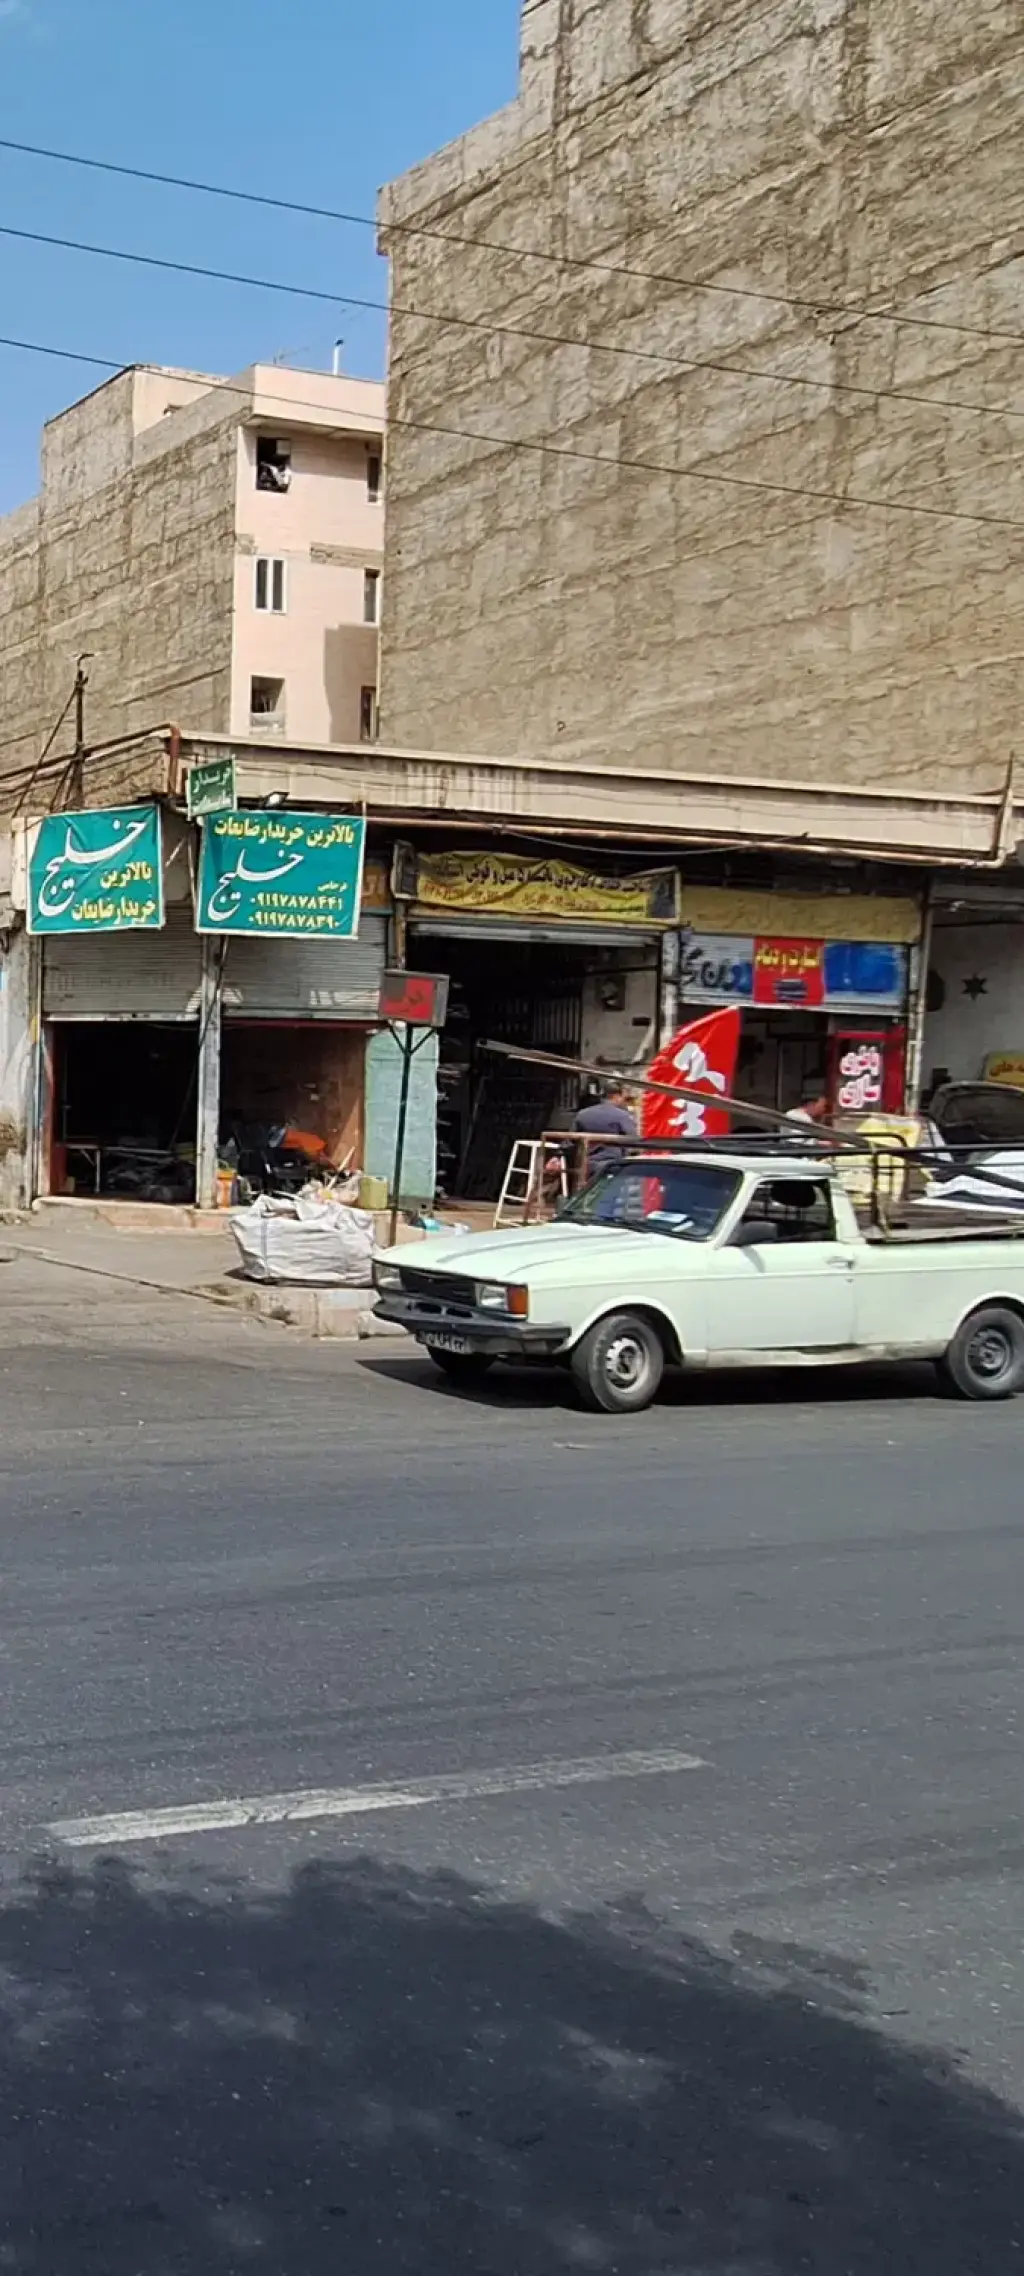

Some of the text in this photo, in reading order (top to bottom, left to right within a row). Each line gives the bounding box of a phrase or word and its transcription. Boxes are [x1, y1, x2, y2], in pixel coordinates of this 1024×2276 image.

[192, 761, 231, 794] خریدار
[214, 817, 355, 849] بالاترین خریدار ضایعات
[37, 819, 147, 917] خلیج
[100, 861, 152, 889] بالاترین
[207, 848, 304, 922] خلیج
[250, 892, 343, 910] ۰۹۱۹۷۸۷۸۴۴۱
[71, 893, 157, 925] خریدار ضایعات
[838, 1073, 881, 1109] سازی
